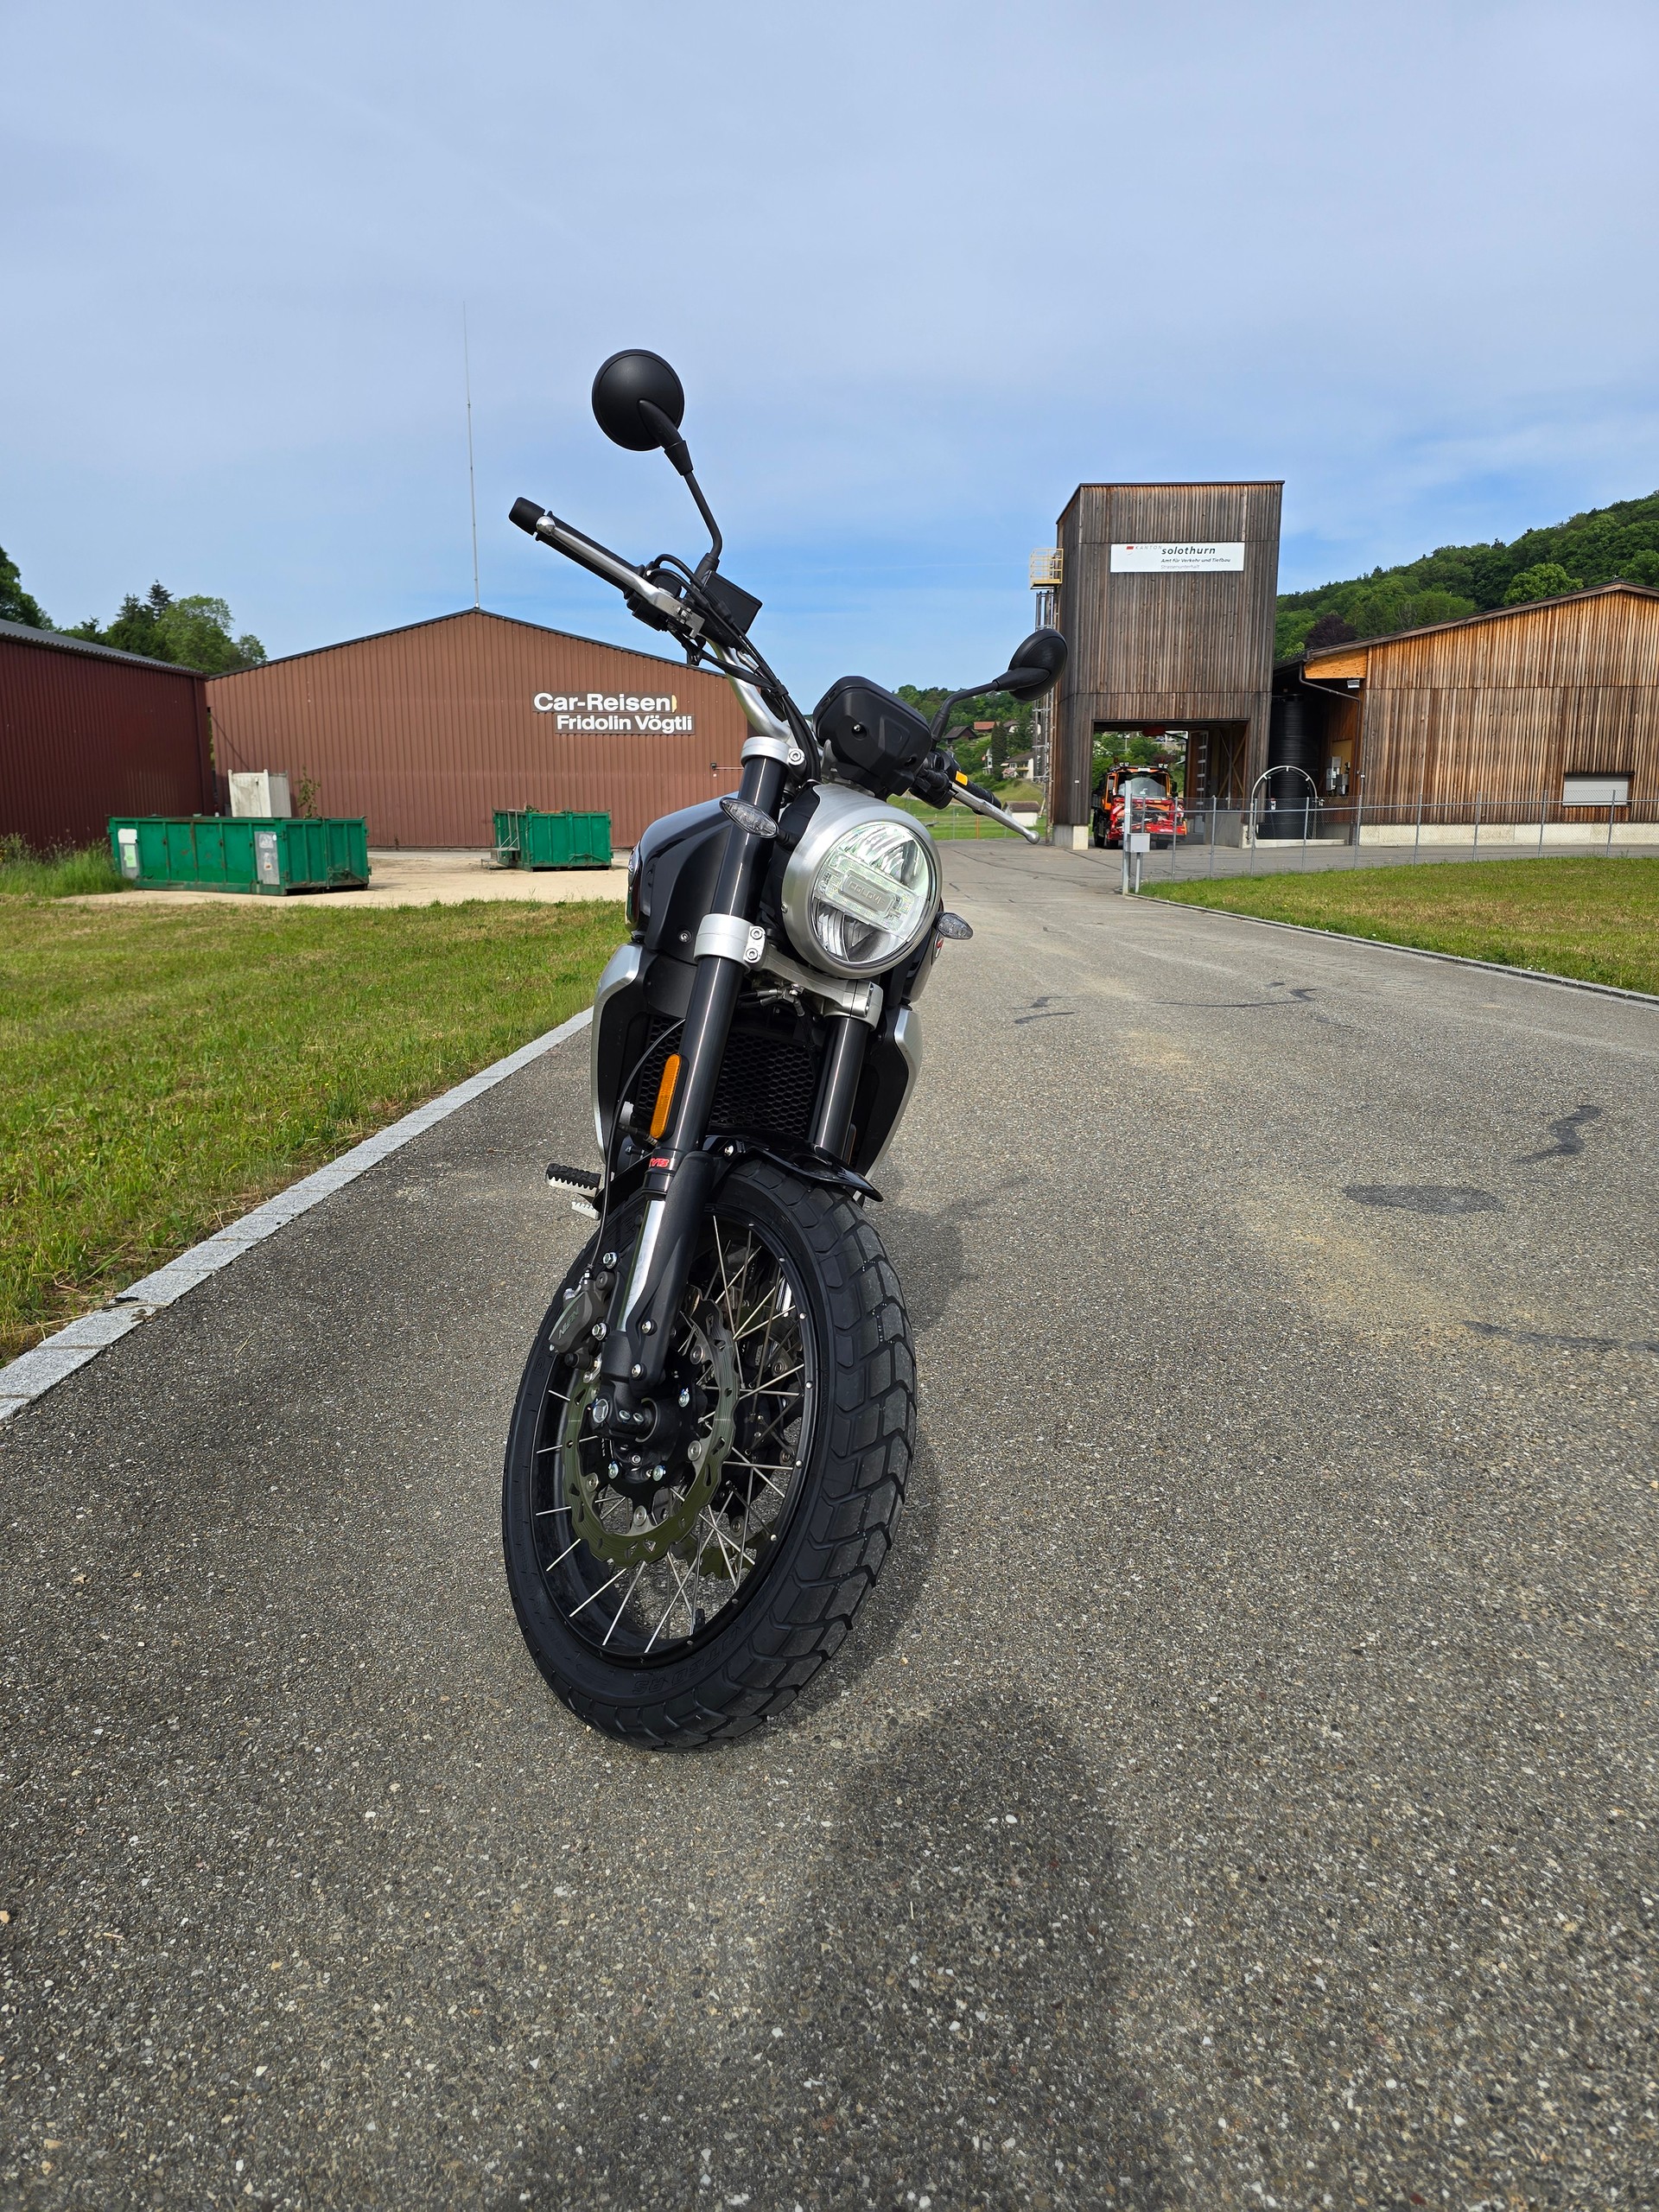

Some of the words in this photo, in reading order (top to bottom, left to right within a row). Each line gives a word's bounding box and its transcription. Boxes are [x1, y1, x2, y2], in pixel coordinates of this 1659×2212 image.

[1161, 546, 1216, 555] solothurn
[533, 692, 671, 711] Car-Reisen
[556, 715, 632, 730] Fridolin
[634, 715, 692, 734] Vögtli
